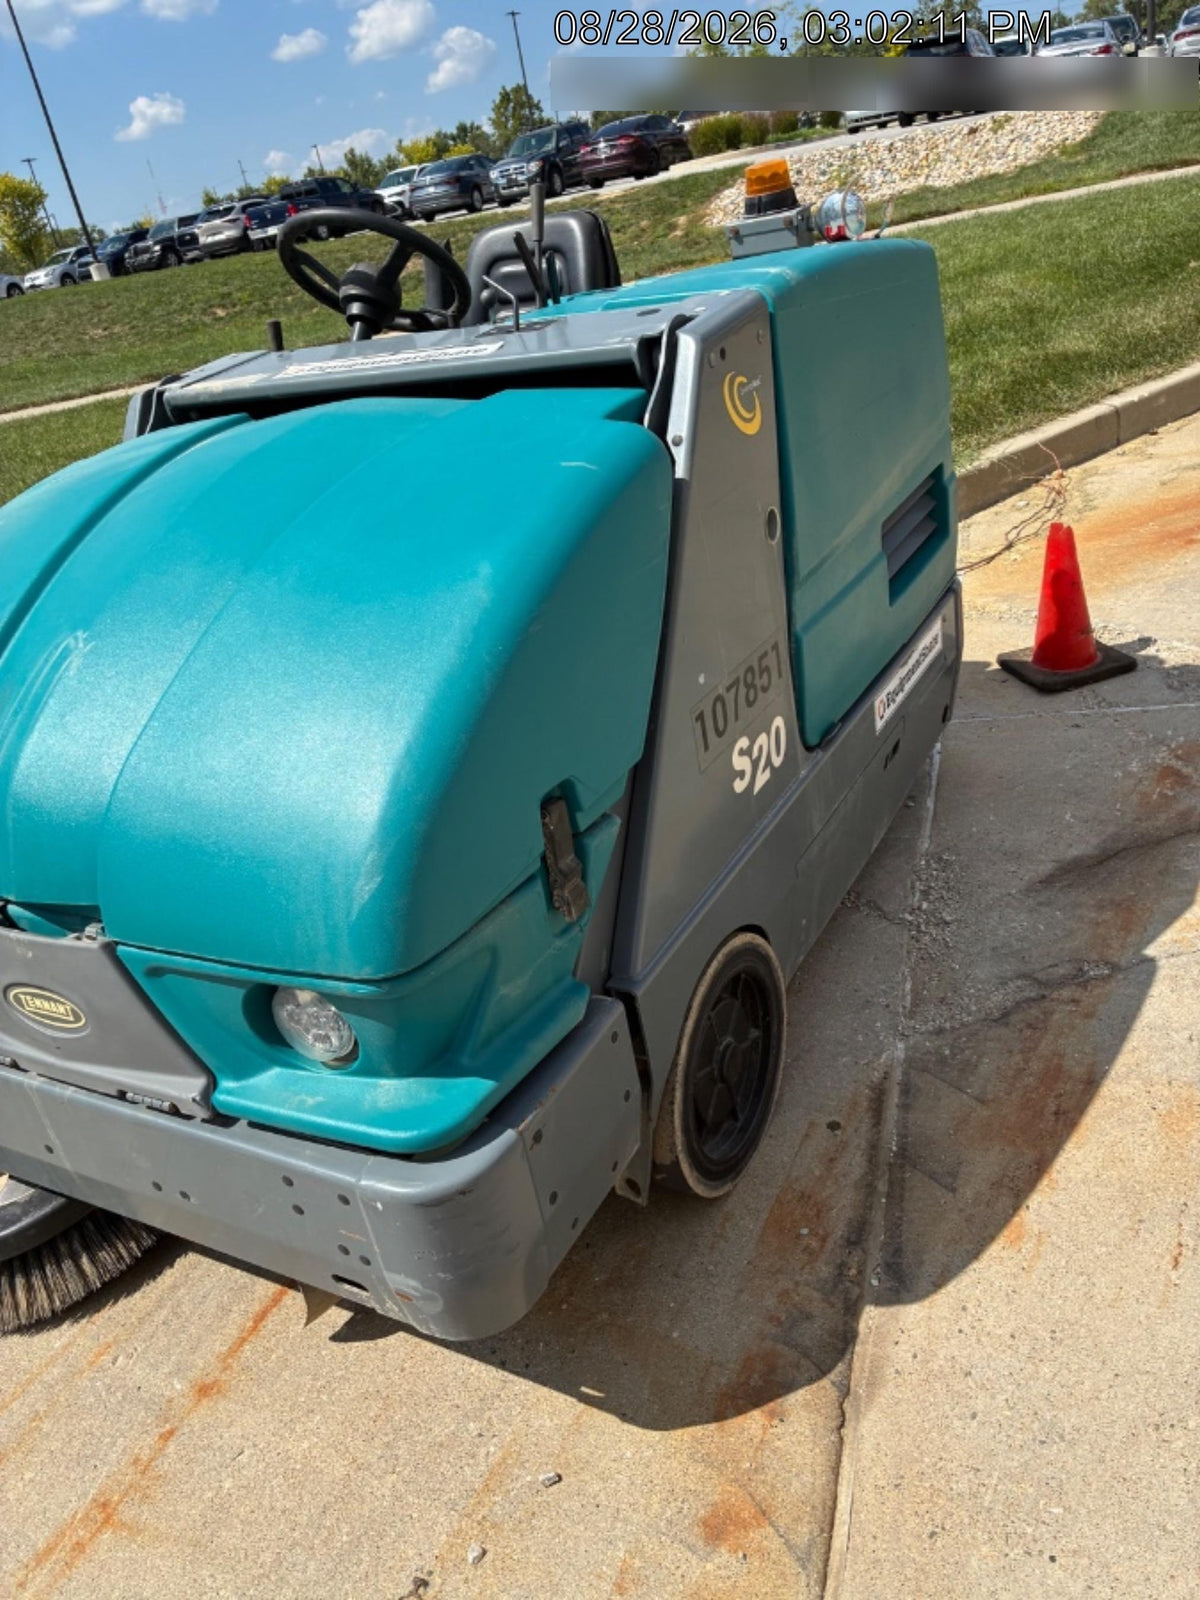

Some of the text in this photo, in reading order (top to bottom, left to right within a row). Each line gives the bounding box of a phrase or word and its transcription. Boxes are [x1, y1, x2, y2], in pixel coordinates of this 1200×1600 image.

[694, 640, 783, 752] 107851
[732, 715, 786, 796] S20
[17, 993, 75, 1021] TENNANT
